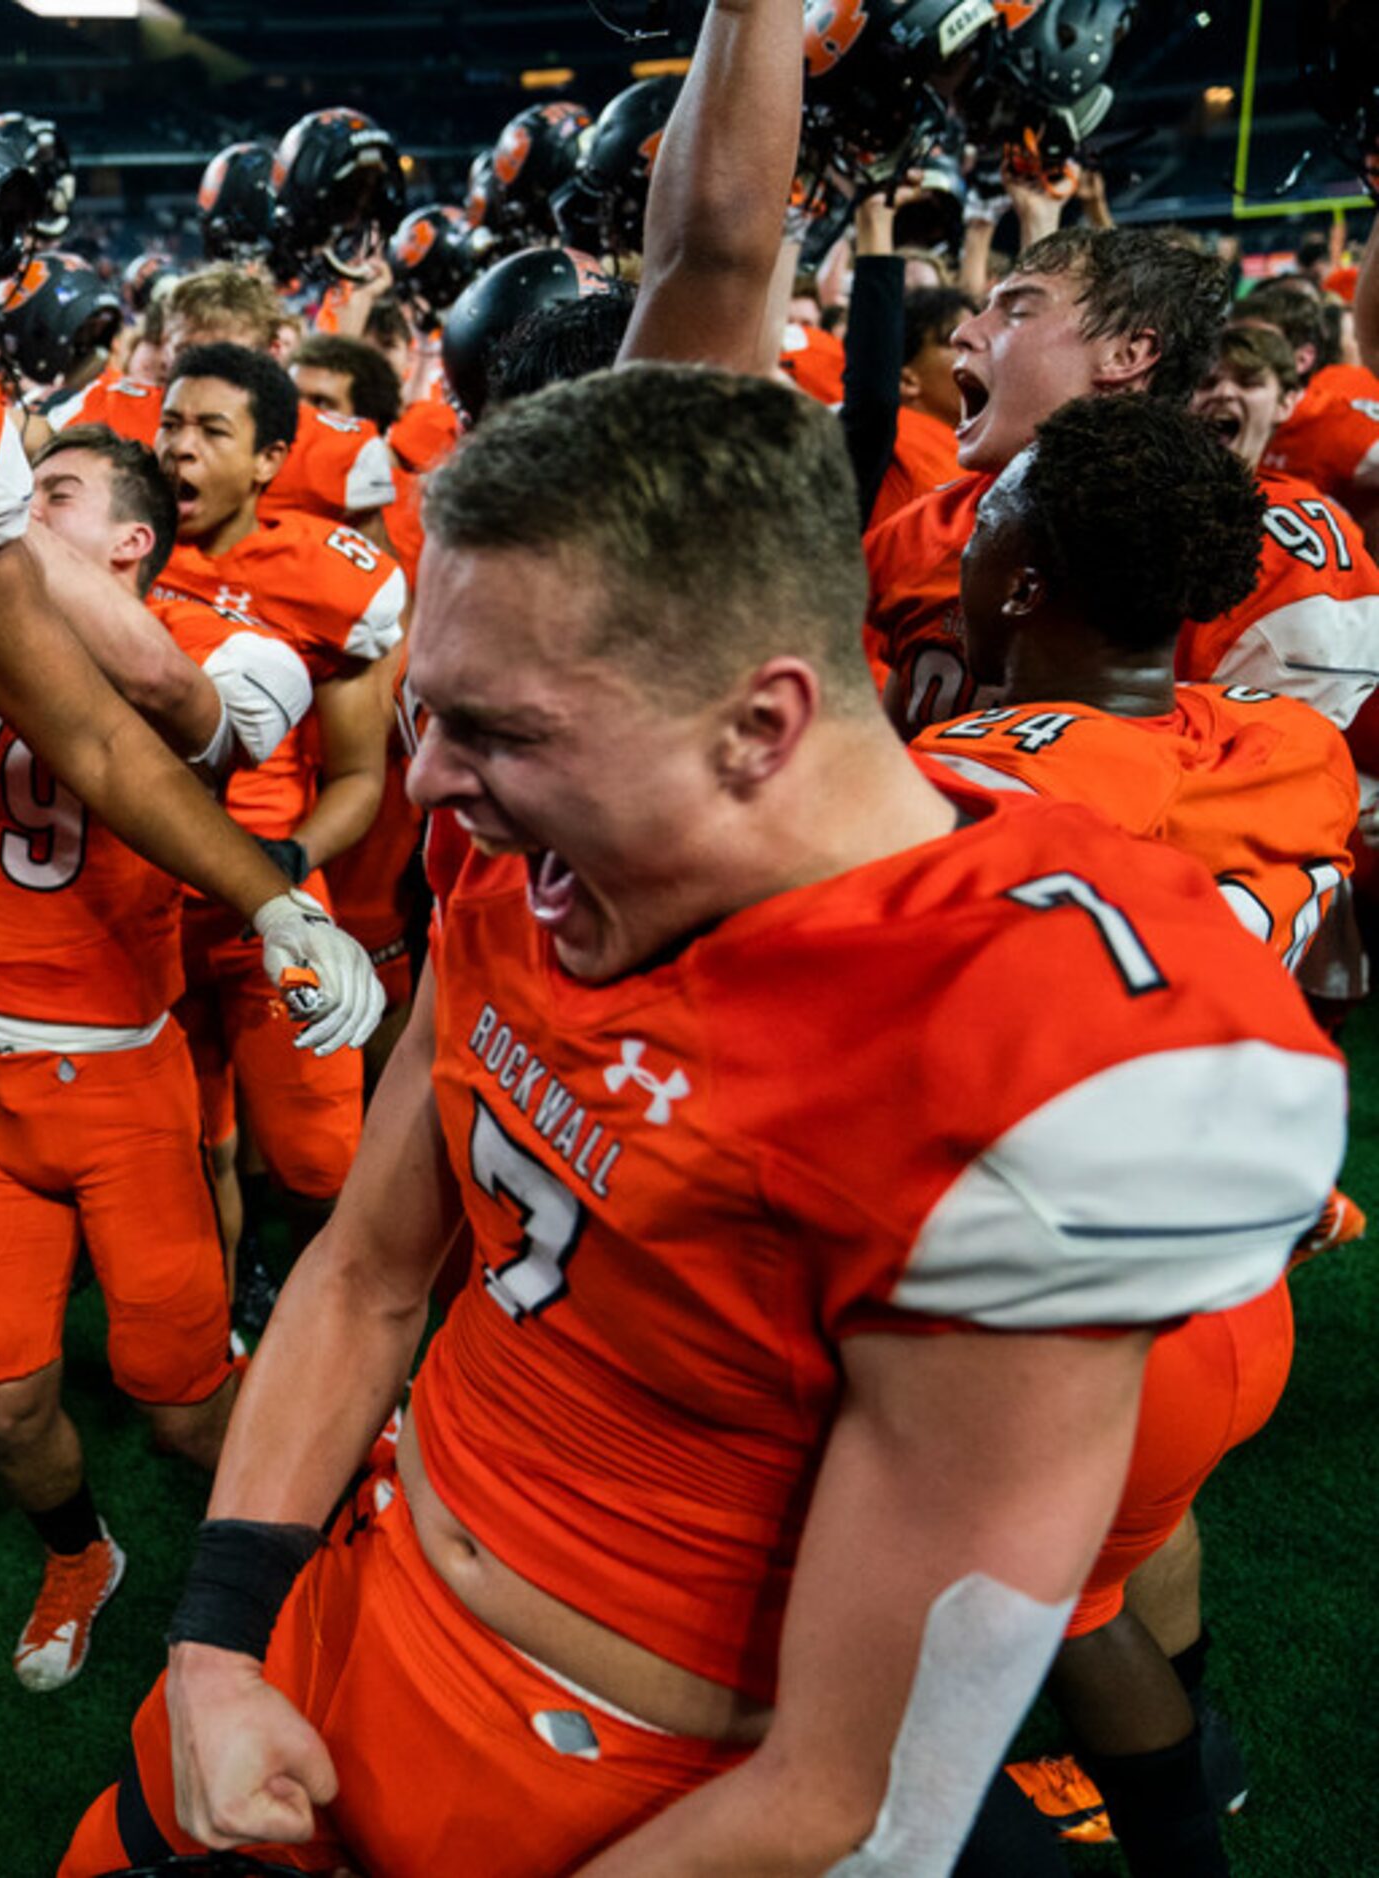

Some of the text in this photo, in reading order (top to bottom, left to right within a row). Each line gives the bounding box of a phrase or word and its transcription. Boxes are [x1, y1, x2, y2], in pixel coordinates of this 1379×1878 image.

[1260, 499, 1352, 571] 97
[936, 704, 1080, 755] 24
[998, 869, 1170, 999] 7
[469, 1003, 621, 1198] ROCKWALL
[469, 1085, 590, 1325] 7
